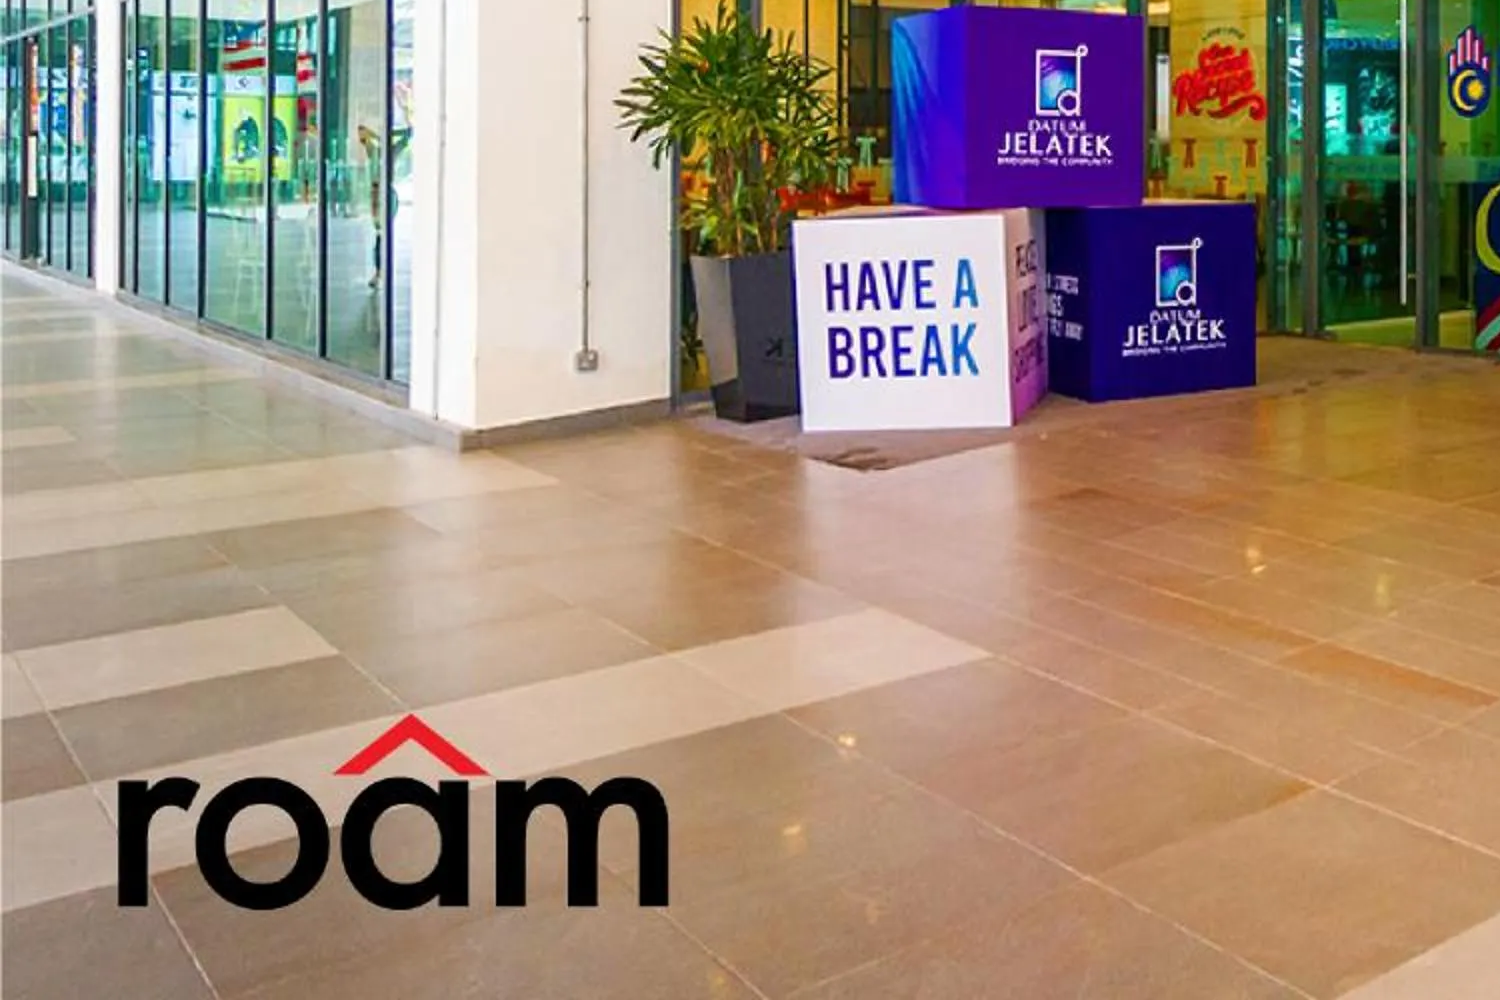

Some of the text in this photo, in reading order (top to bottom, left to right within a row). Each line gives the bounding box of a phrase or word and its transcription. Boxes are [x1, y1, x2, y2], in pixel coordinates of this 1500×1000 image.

[998, 131, 1113, 157] JELATEK
[825, 259, 937, 311] HAVE
[953, 258, 980, 309] A
[827, 322, 980, 379] BREAK
[1122, 319, 1227, 348] JELATEK
